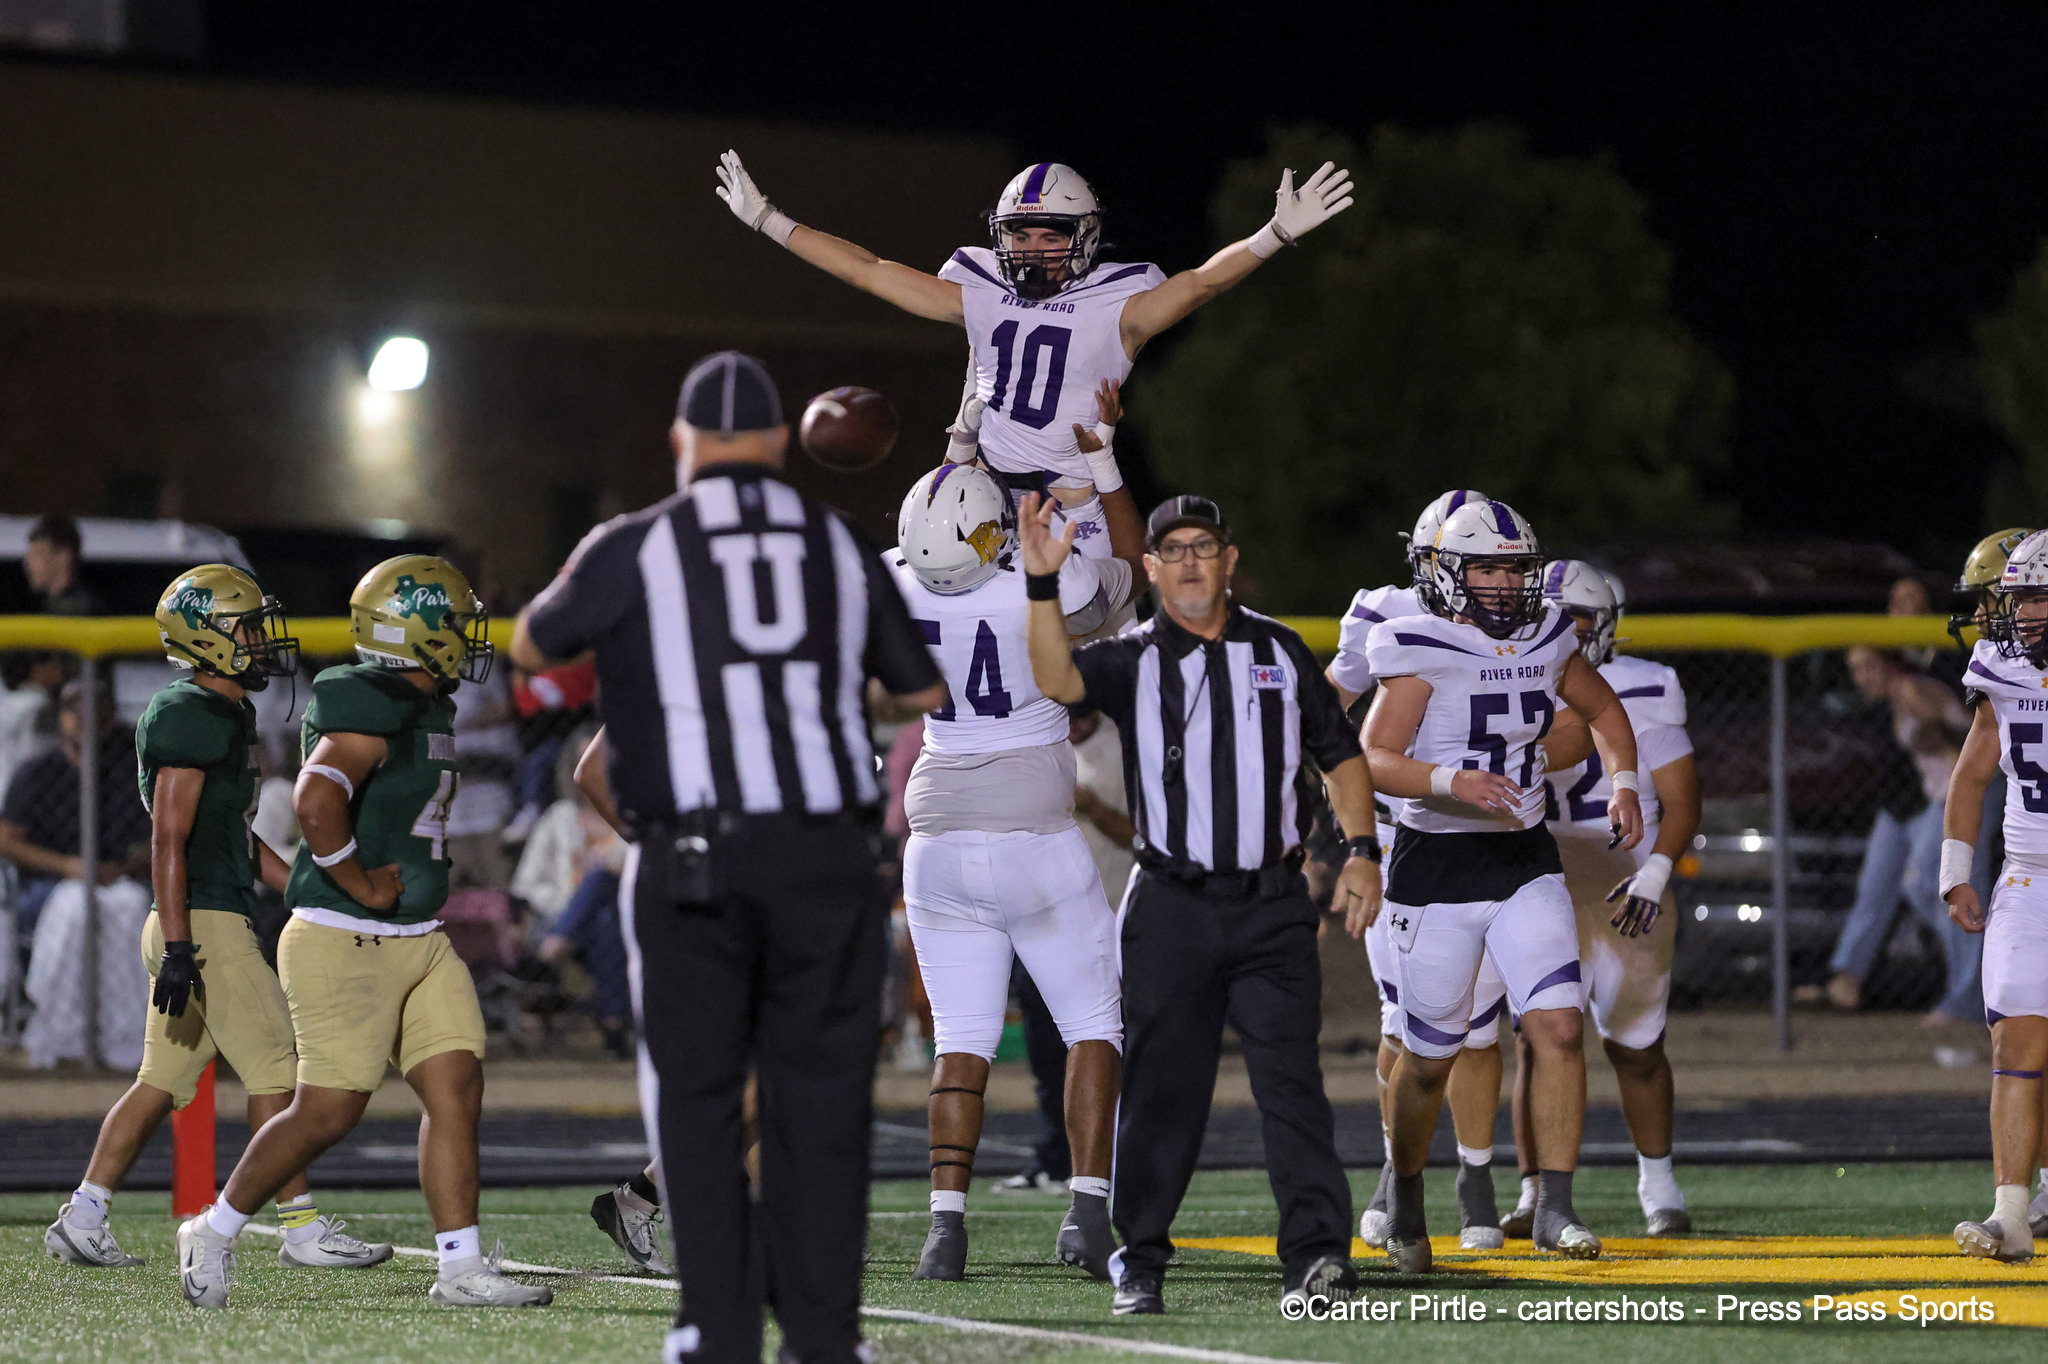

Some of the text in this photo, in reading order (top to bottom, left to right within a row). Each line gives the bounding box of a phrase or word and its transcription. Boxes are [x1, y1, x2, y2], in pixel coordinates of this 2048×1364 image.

[1001, 294, 1075, 314] RIVER ROAD
[988, 319, 1072, 430] 10
[709, 533, 806, 654] U
[1250, 668, 1283, 682] TSO
[1480, 665, 1545, 681] RIVER ROAD
[1462, 690, 1554, 788] 57
[2009, 723, 2048, 813] 5
